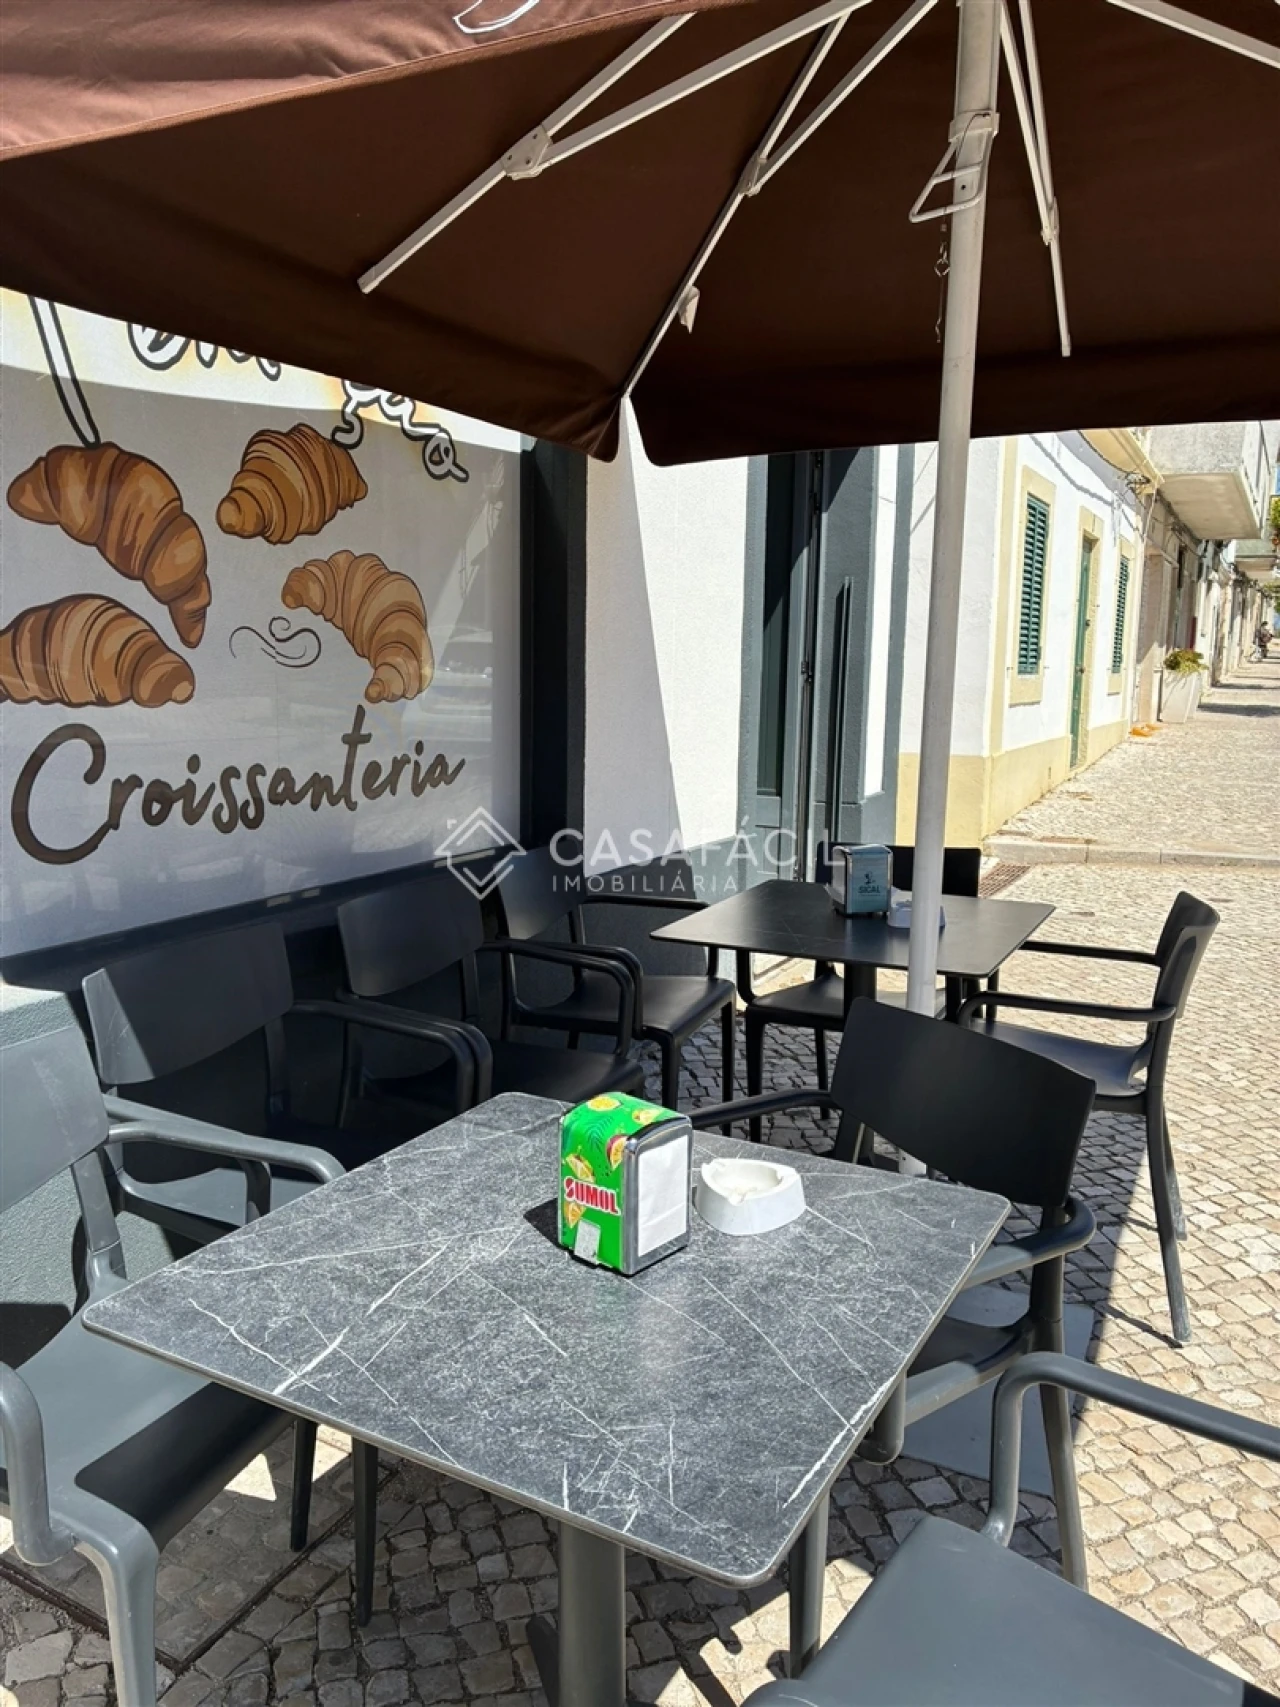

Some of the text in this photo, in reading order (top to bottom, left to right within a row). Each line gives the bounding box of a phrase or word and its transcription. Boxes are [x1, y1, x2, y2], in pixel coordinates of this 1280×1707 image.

[10, 704, 466, 866] Croissanteria
[858, 885, 881, 894] SICAL
[564, 1176, 621, 1215] SUMOL
